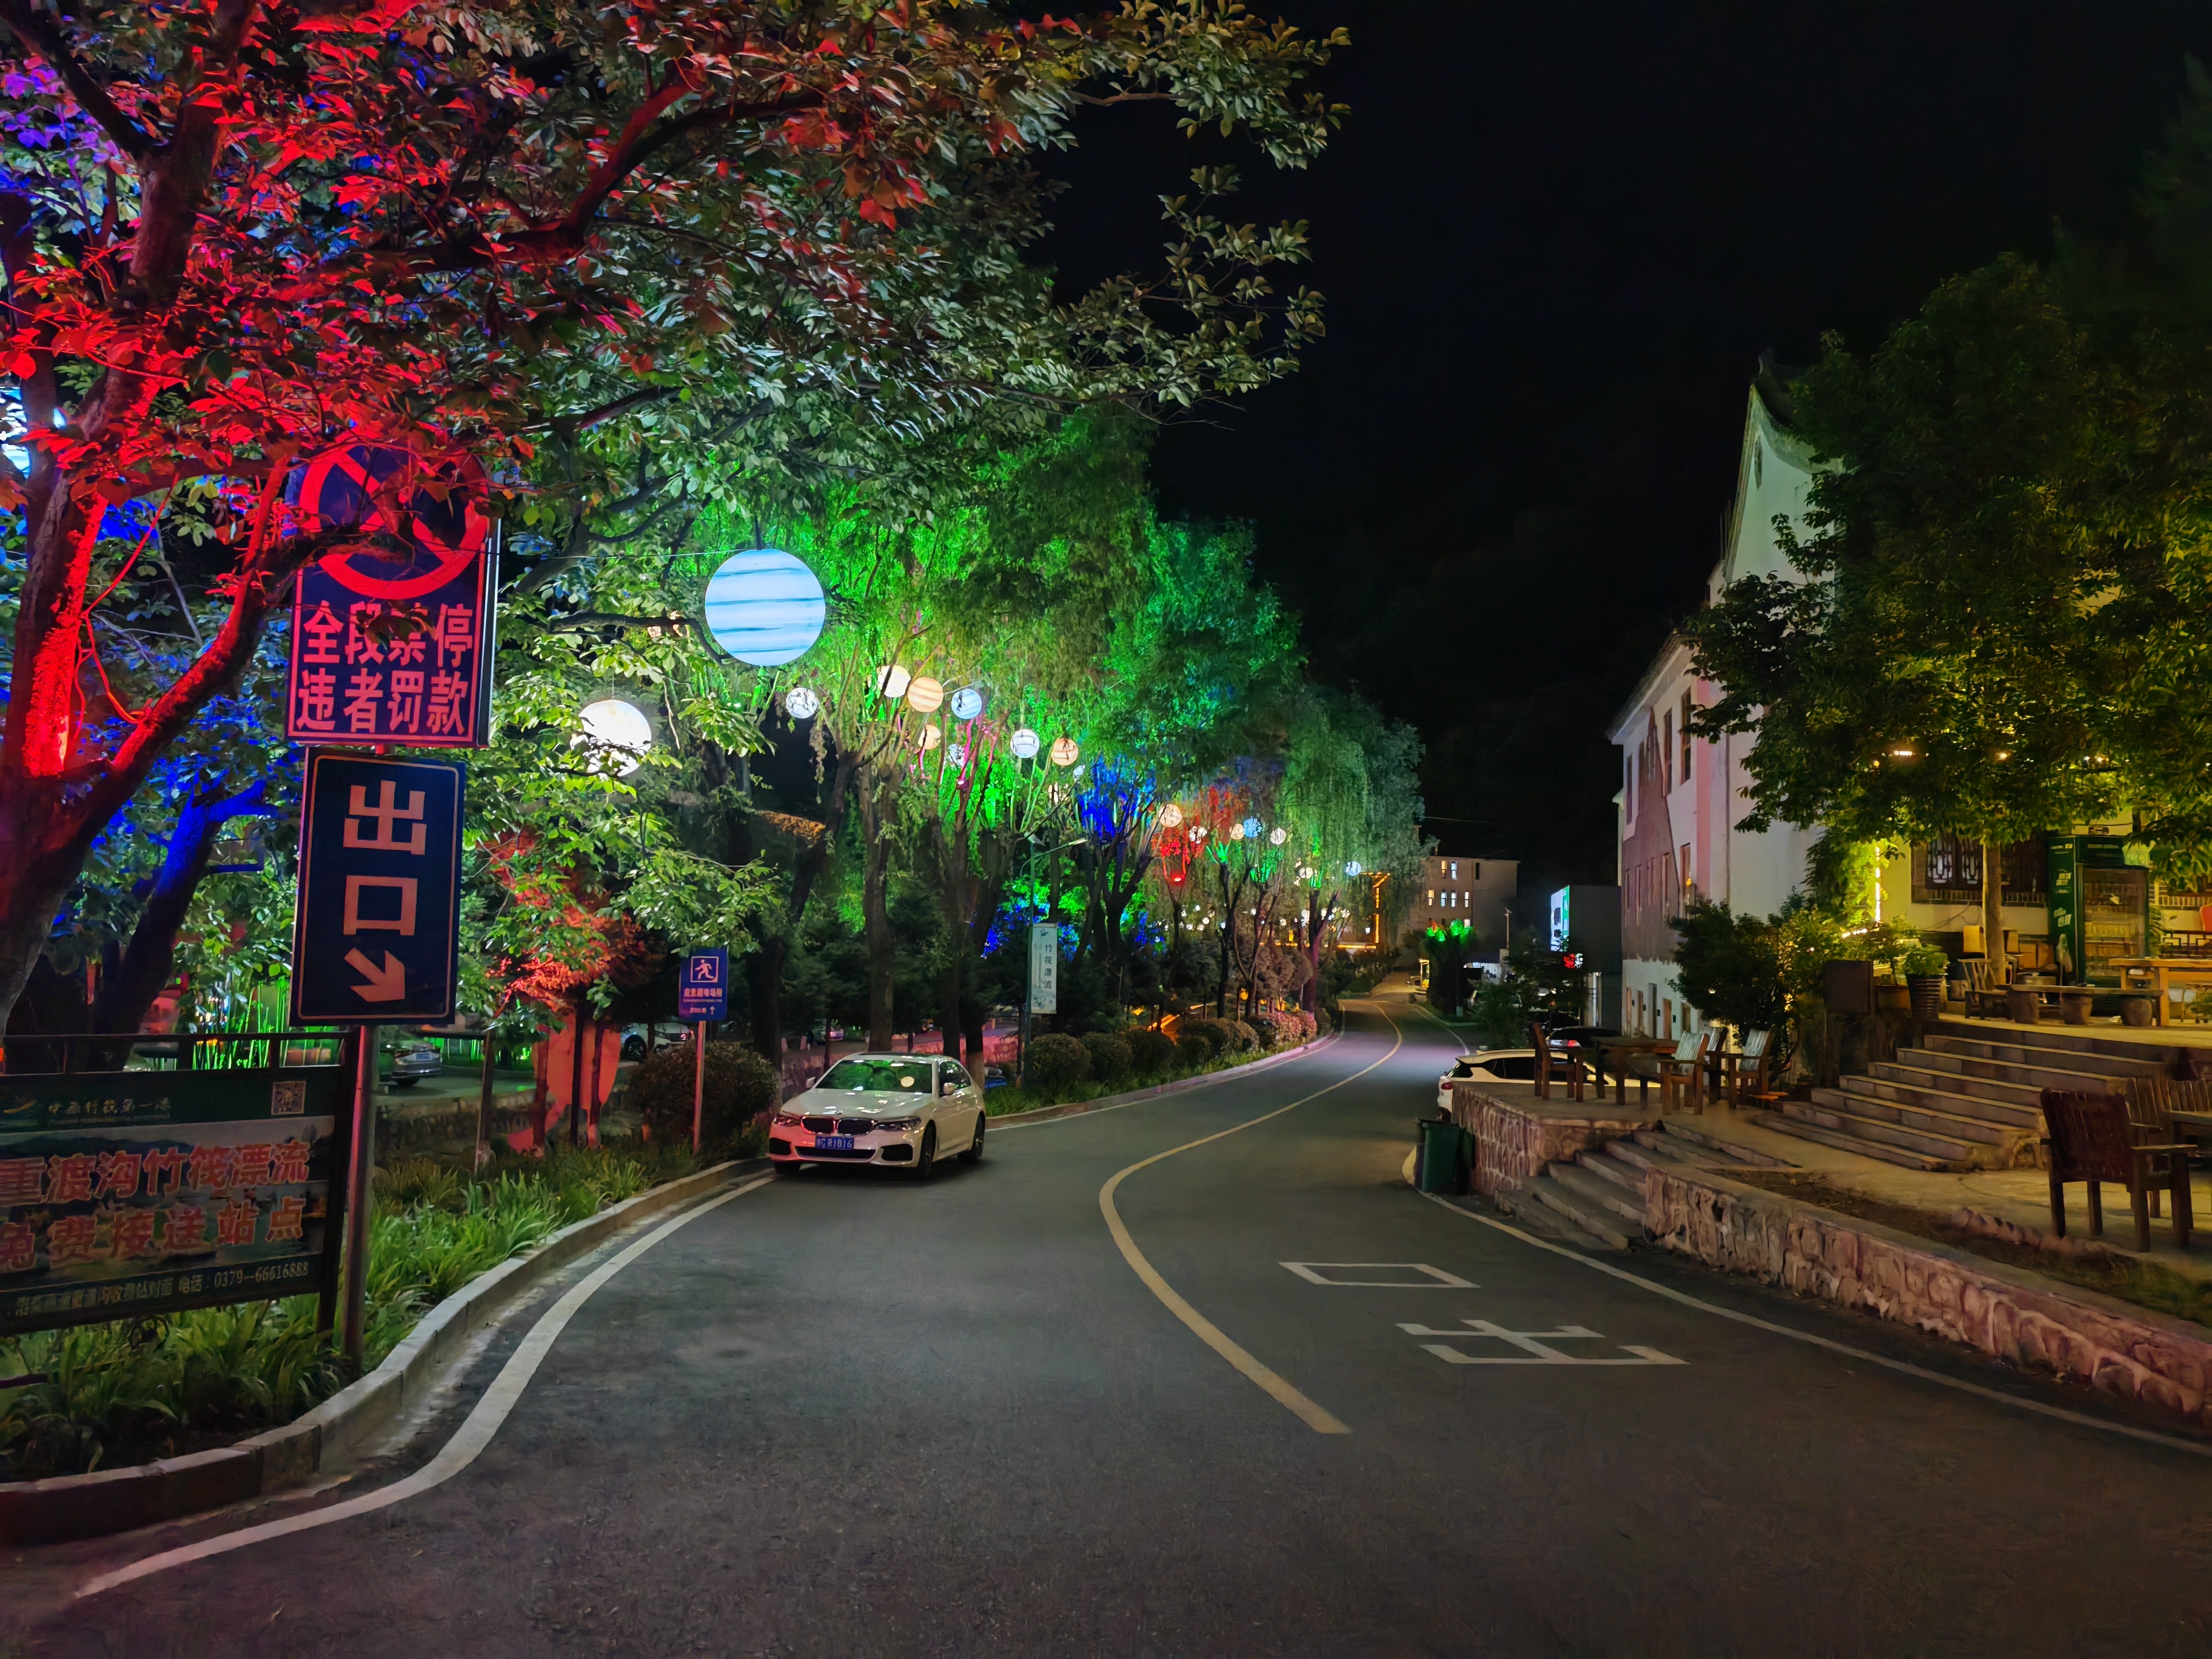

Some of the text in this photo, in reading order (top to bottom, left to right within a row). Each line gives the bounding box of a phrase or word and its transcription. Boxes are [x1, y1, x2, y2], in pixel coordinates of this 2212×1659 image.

[296, 667, 469, 735] 违者罚款
[343, 780, 427, 936] 出口
[0, 1140, 310, 1204] 重渡沟竹筏漂流
[0, 1196, 306, 1271] 免费接送站点
